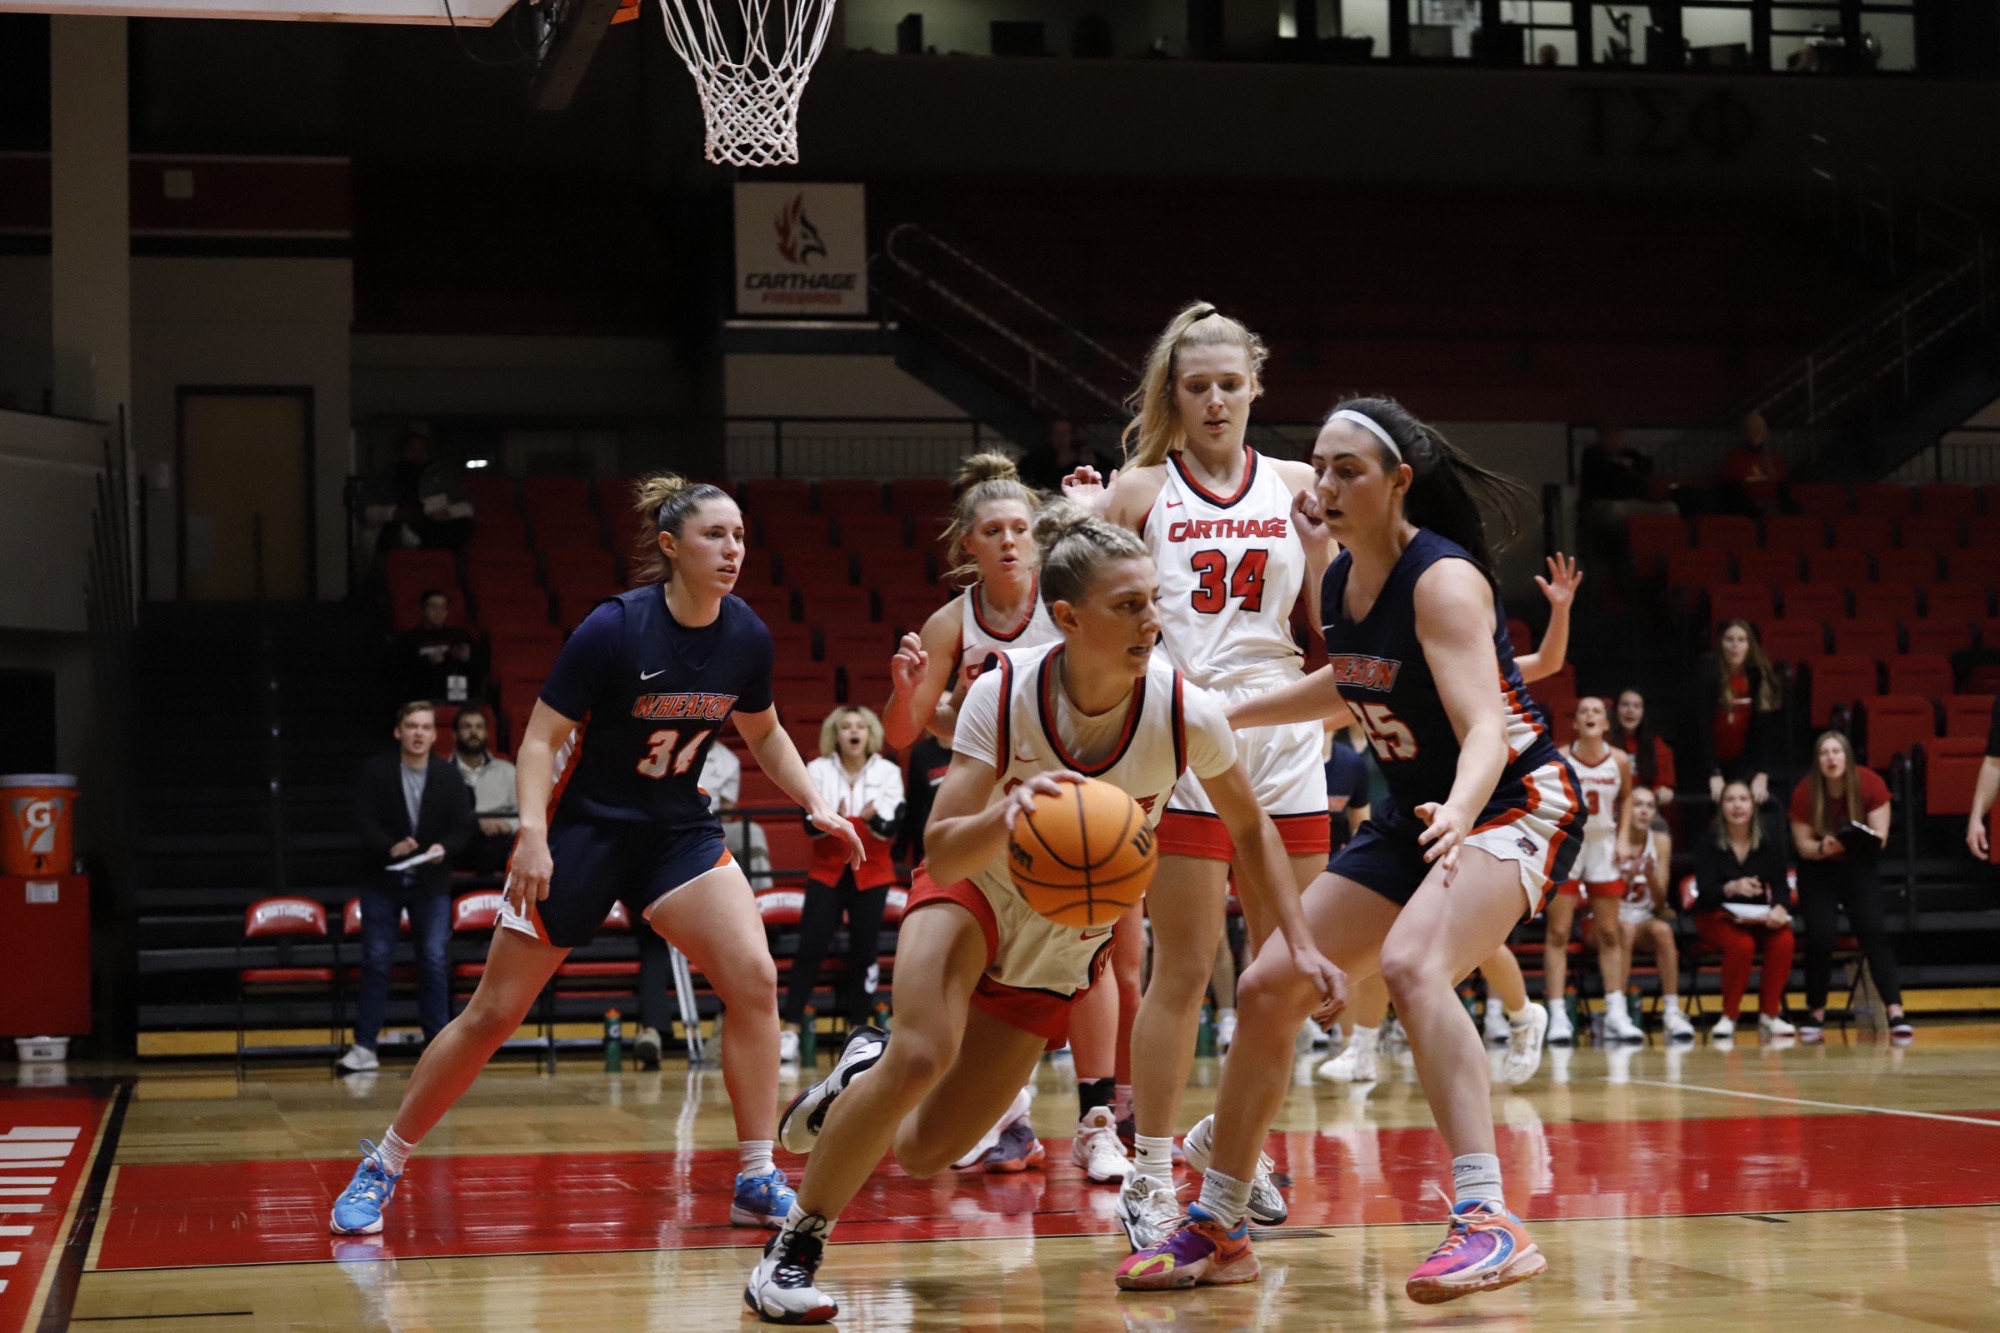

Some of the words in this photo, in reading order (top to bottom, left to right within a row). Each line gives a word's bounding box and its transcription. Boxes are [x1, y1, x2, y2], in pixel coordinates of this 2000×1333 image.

[745, 273, 857, 290] CARTHAGE
[1167, 517, 1287, 543] CARTHAGE
[1190, 548, 1268, 614] 34
[631, 692, 739, 721] WHEATON
[26, 800, 52, 829] G
